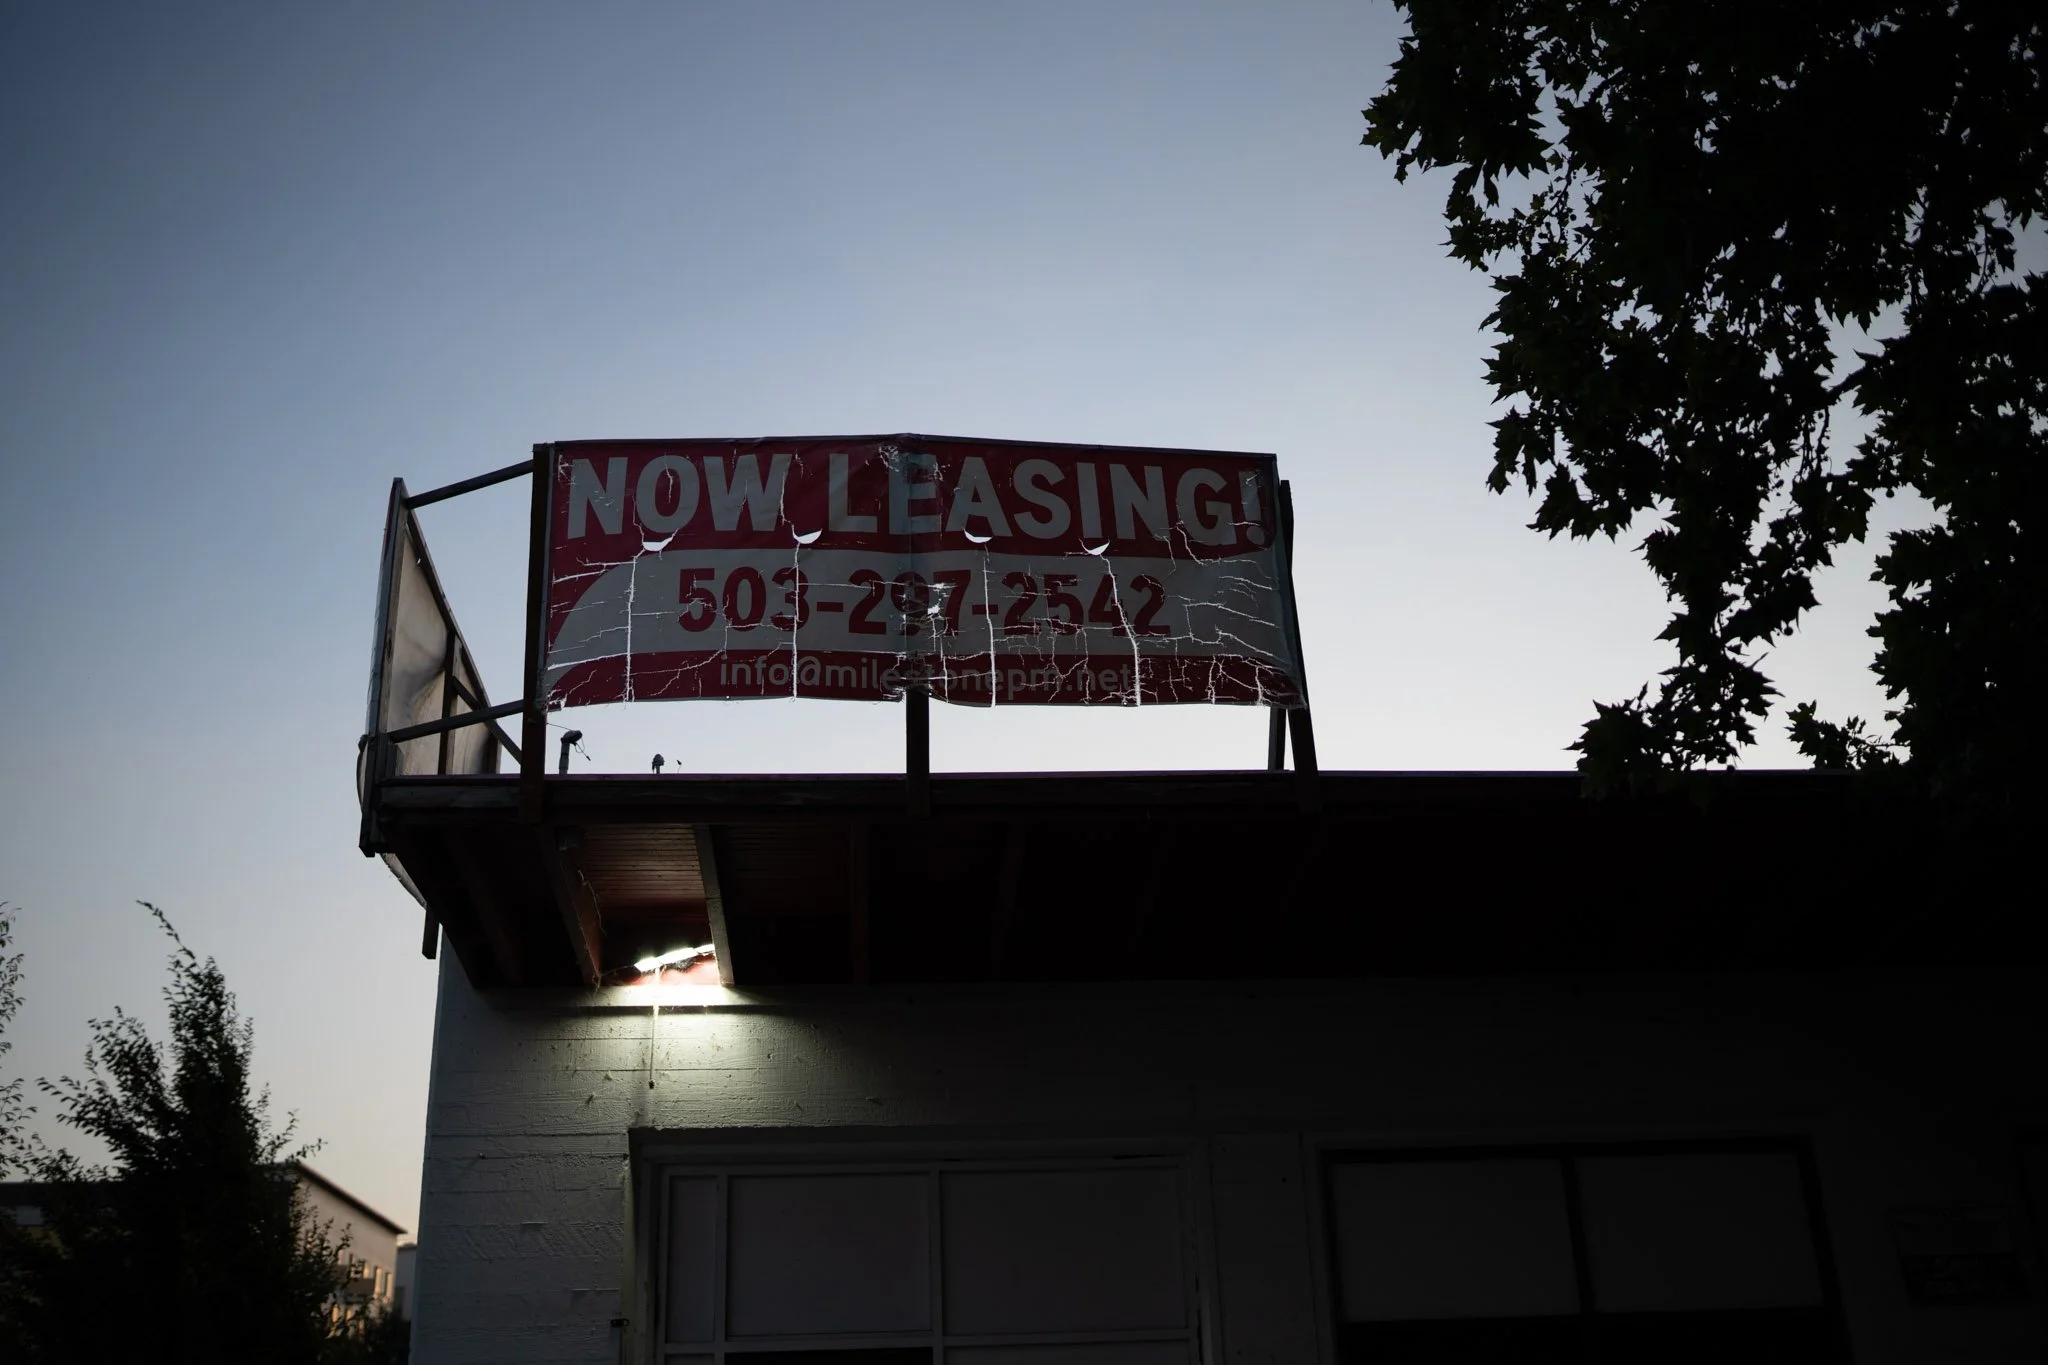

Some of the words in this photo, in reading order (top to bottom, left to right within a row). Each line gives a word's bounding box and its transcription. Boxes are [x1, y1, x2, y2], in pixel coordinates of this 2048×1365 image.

[567, 453, 792, 540] NOW
[828, 453, 1266, 546] LEASING!
[678, 567, 1171, 636] 503-297-2542
